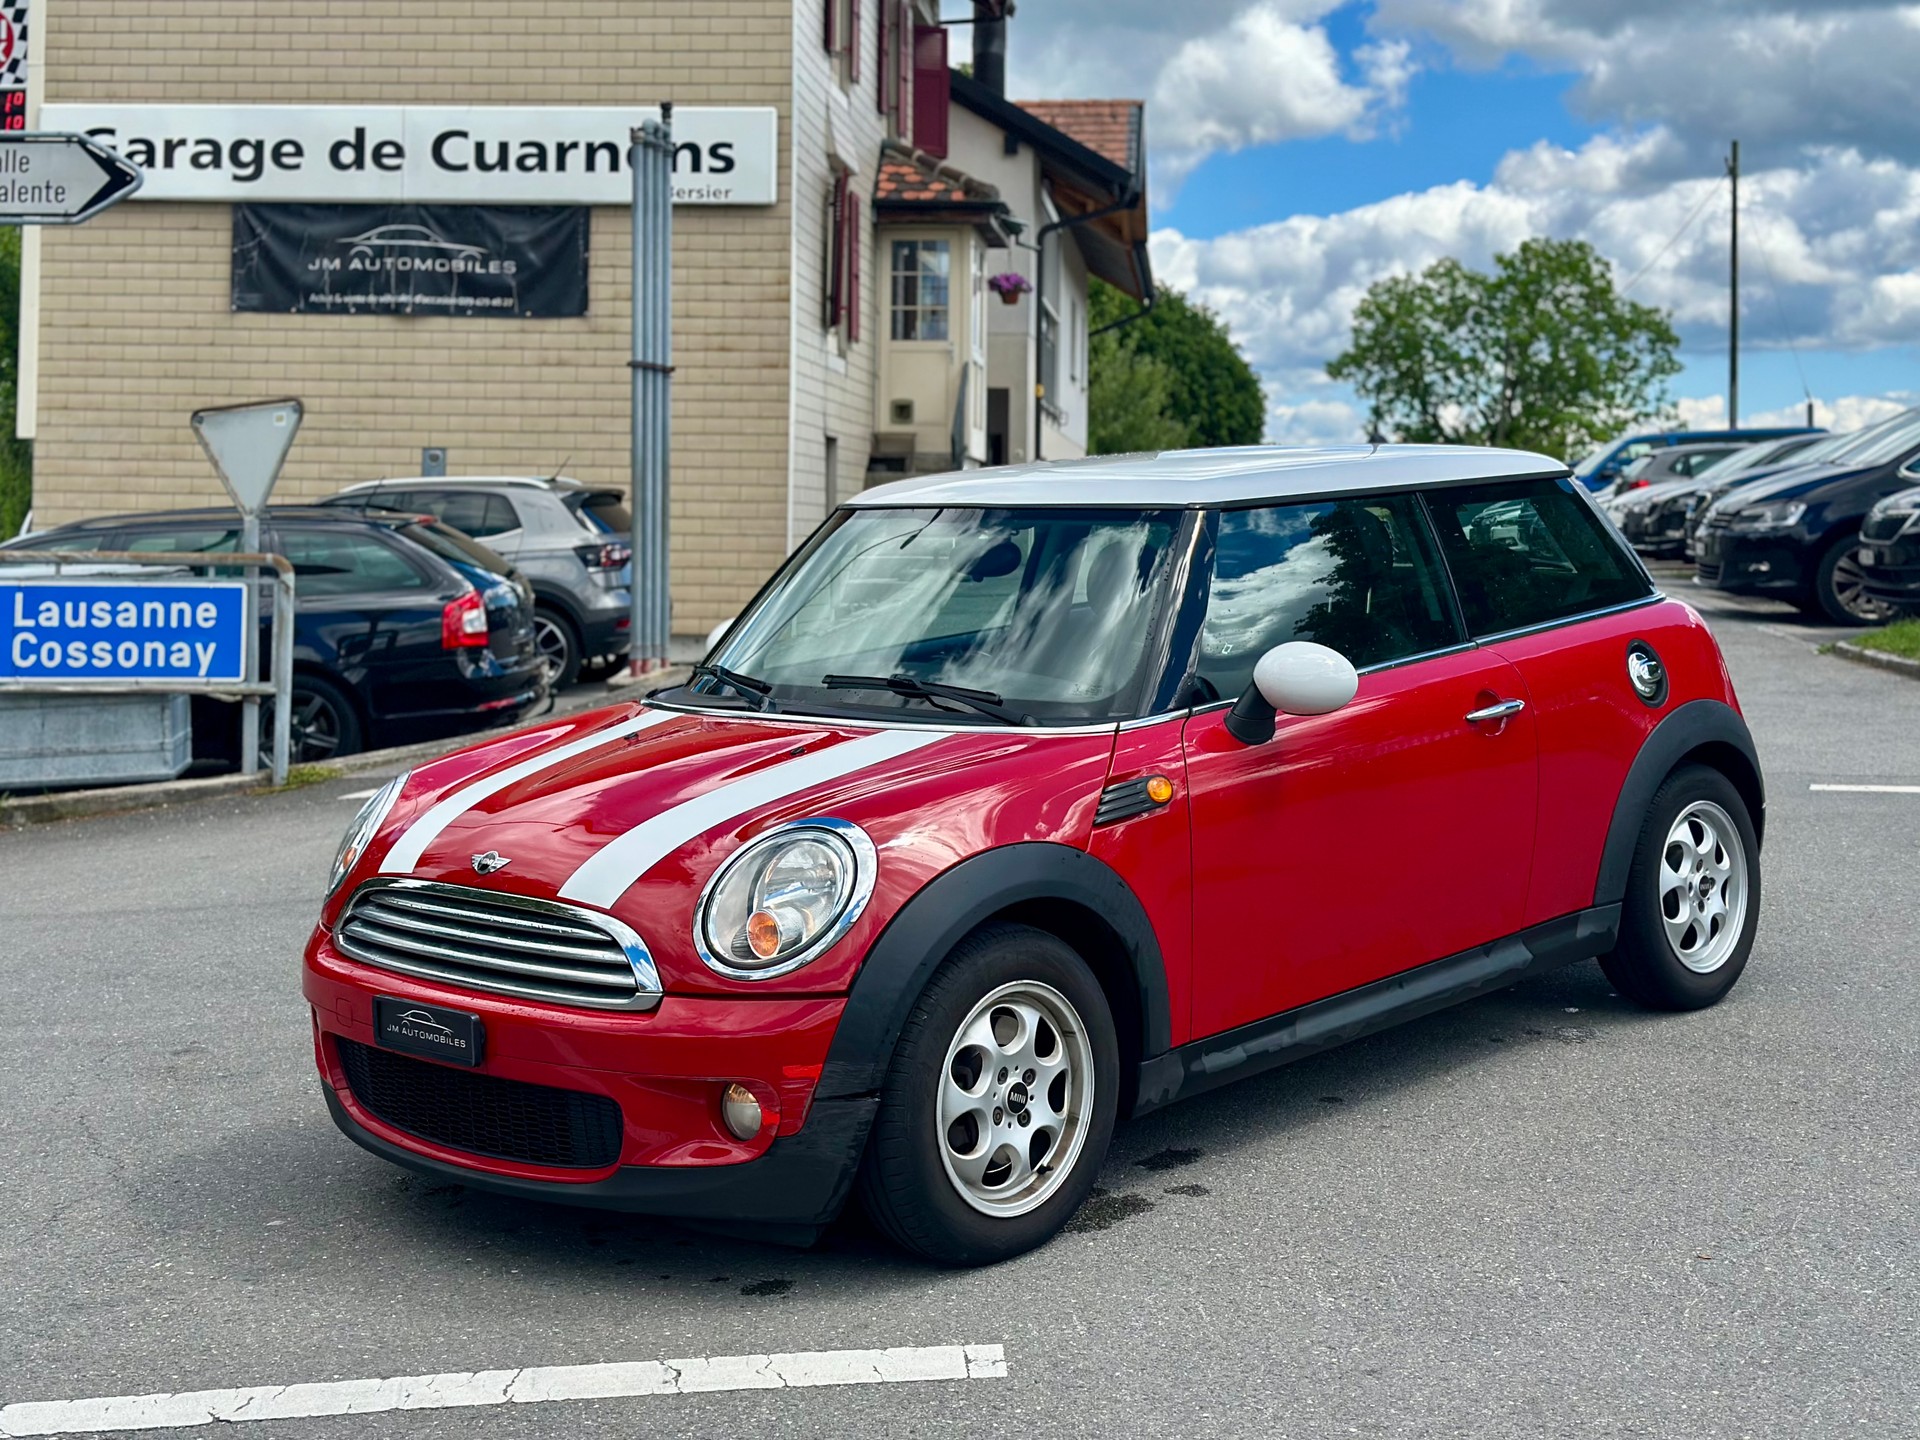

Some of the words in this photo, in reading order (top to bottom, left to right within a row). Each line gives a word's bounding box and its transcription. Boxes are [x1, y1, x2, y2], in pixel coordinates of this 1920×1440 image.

[0, 149, 30, 173] lle
[328, 127, 406, 171] de
[431, 129, 735, 174] Cuarnns
[307, 257, 341, 271] JM
[349, 257, 517, 274] AUTOMOBILES
[13, 591, 217, 628] Lausanne
[12, 631, 216, 676] Cossonay
[386, 1024, 399, 1033] JM
[402, 1027, 466, 1048] AUTOMOBILES
[1010, 1091, 1026, 1104] MINI
